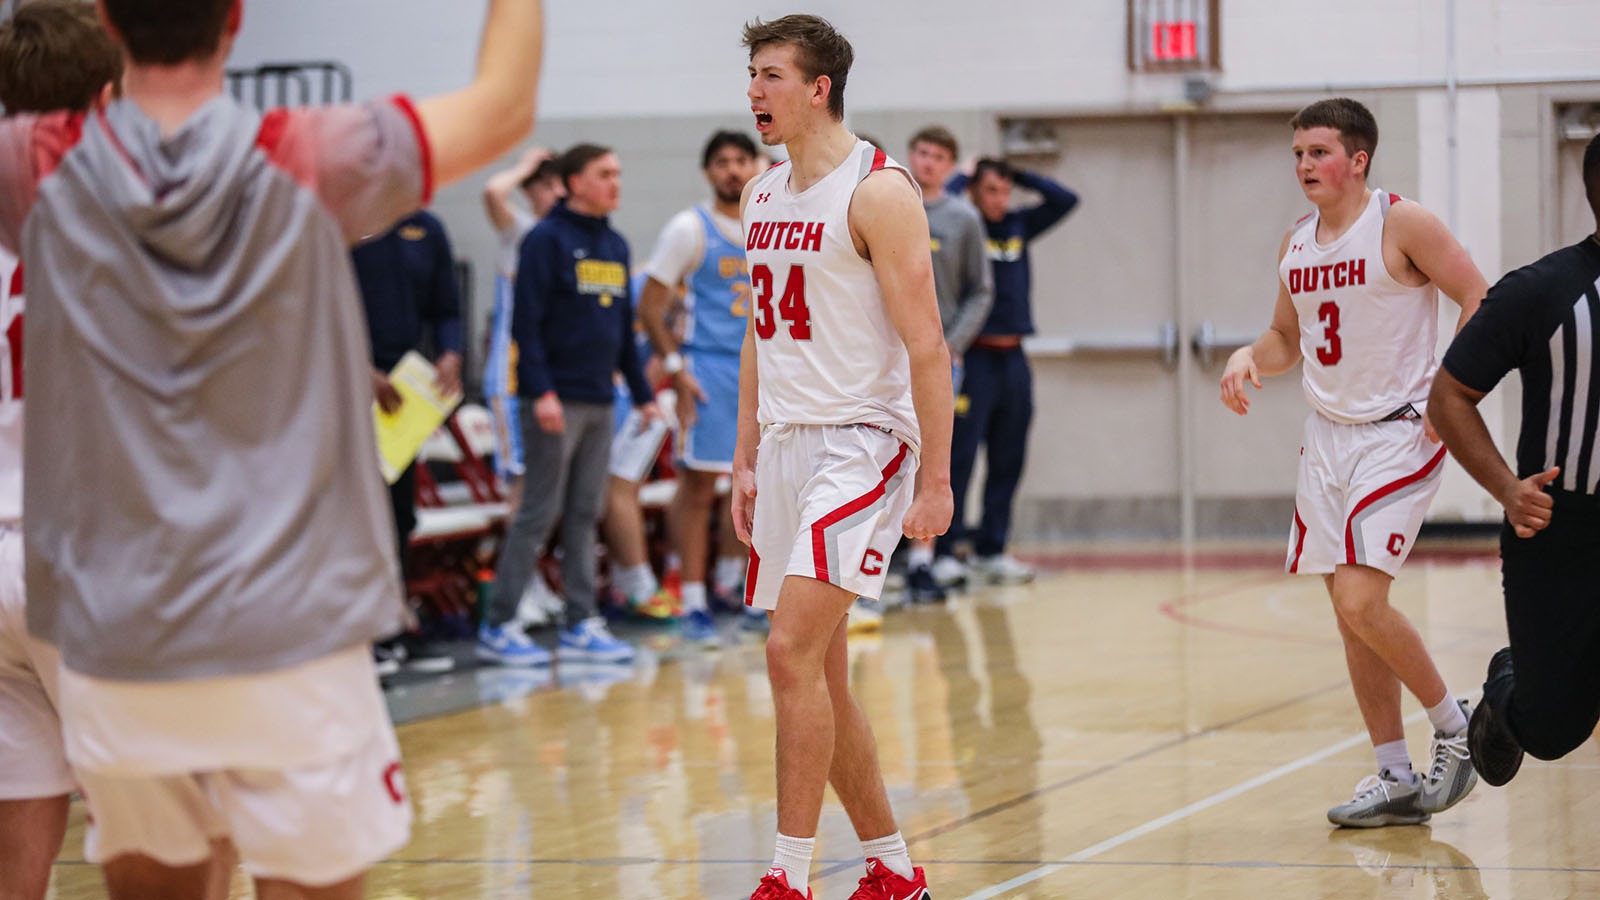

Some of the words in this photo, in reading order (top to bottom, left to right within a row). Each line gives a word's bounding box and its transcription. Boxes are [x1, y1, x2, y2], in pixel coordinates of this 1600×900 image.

[746, 221, 825, 252] DUTCH
[1289, 258, 1366, 295] DUTCH
[751, 263, 813, 341] 34
[1316, 301, 1342, 367] 3
[1386, 532, 1405, 557] C
[859, 548, 884, 576] C
